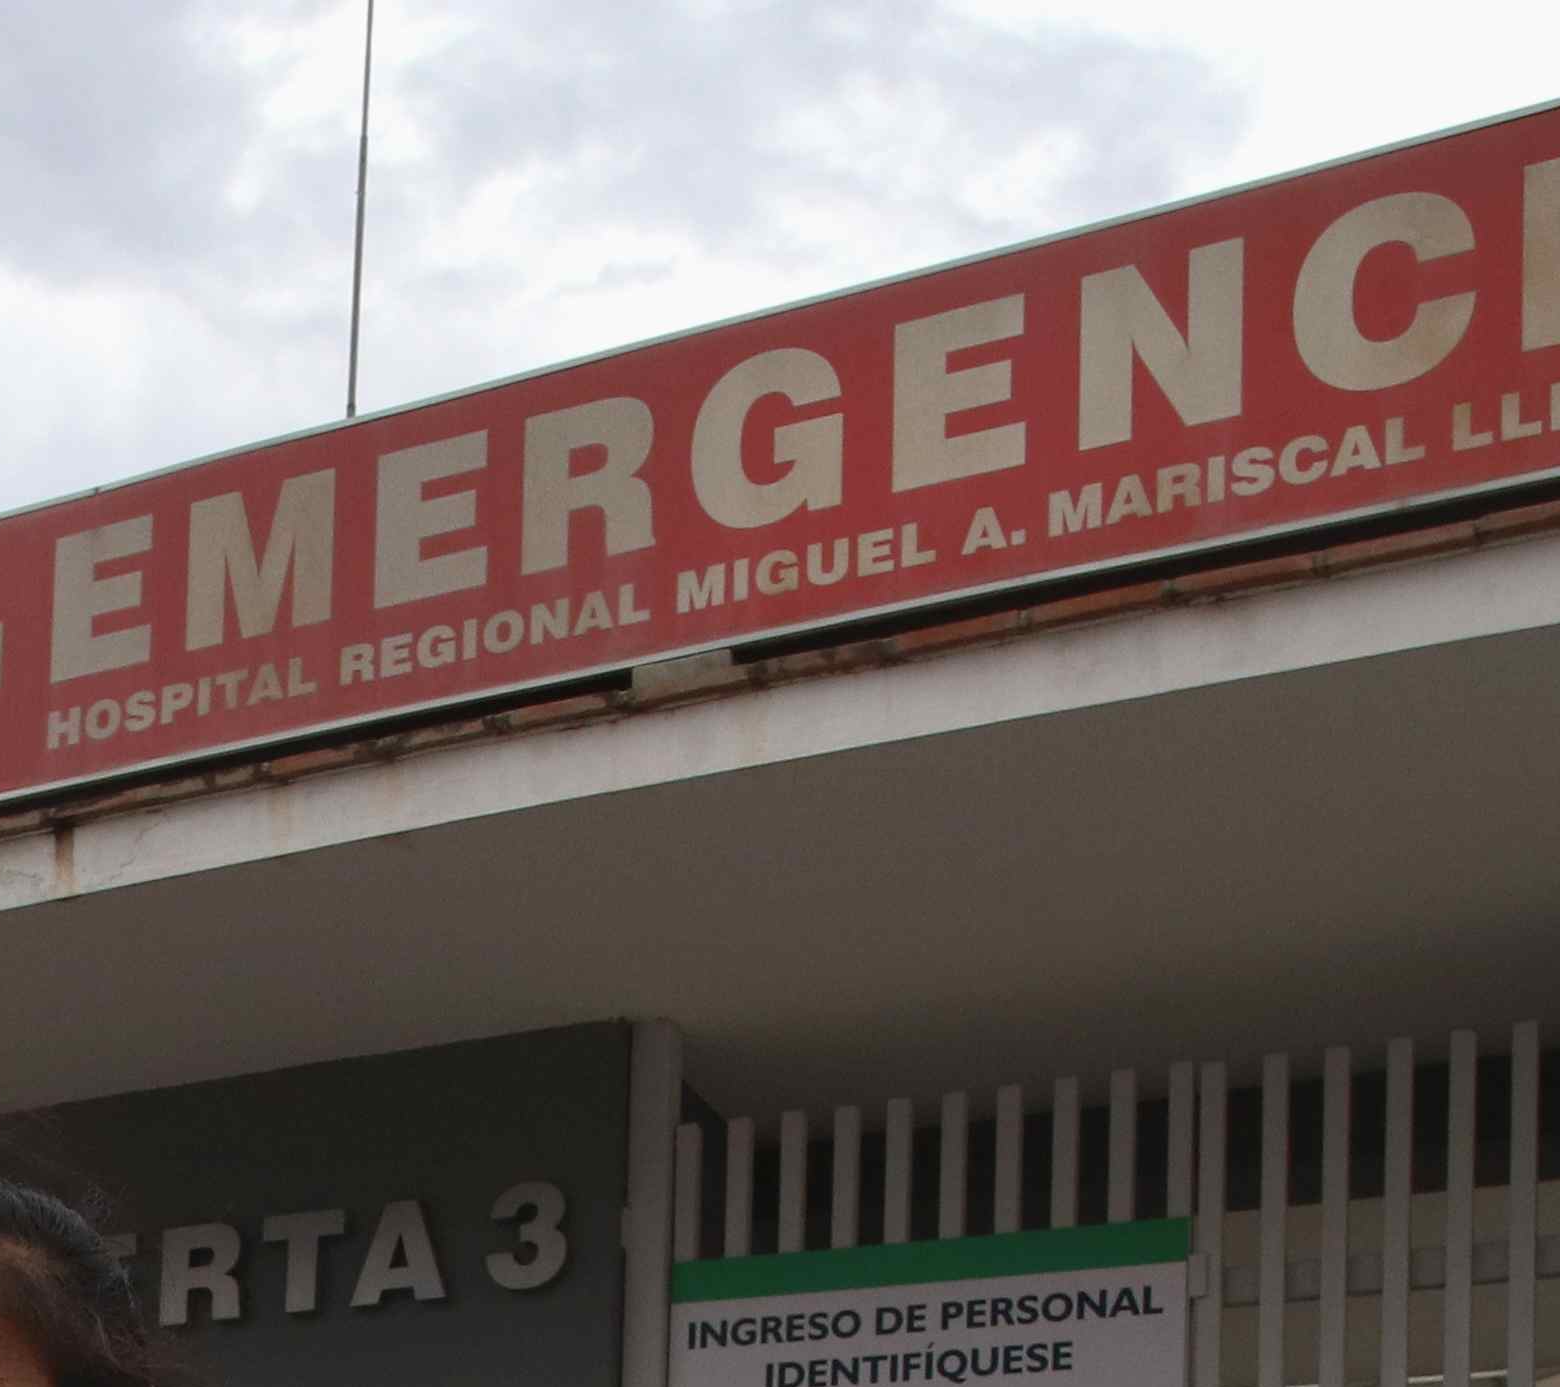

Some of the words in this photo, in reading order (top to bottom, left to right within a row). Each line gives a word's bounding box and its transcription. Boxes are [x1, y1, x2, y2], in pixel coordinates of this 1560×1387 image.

[46, 651, 316, 750] HOSPITAL
[339, 584, 651, 688] REGIONAL
[675, 527, 936, 615] MIGUEL
[962, 507, 1027, 557] A.
[1048, 417, 1426, 538] MARISCAL
[485, 1180, 568, 1291] 3
[687, 1309, 861, 1350] INGRESO
[875, 1302, 927, 1337] DE
[941, 1285, 1165, 1332] PERSONAL
